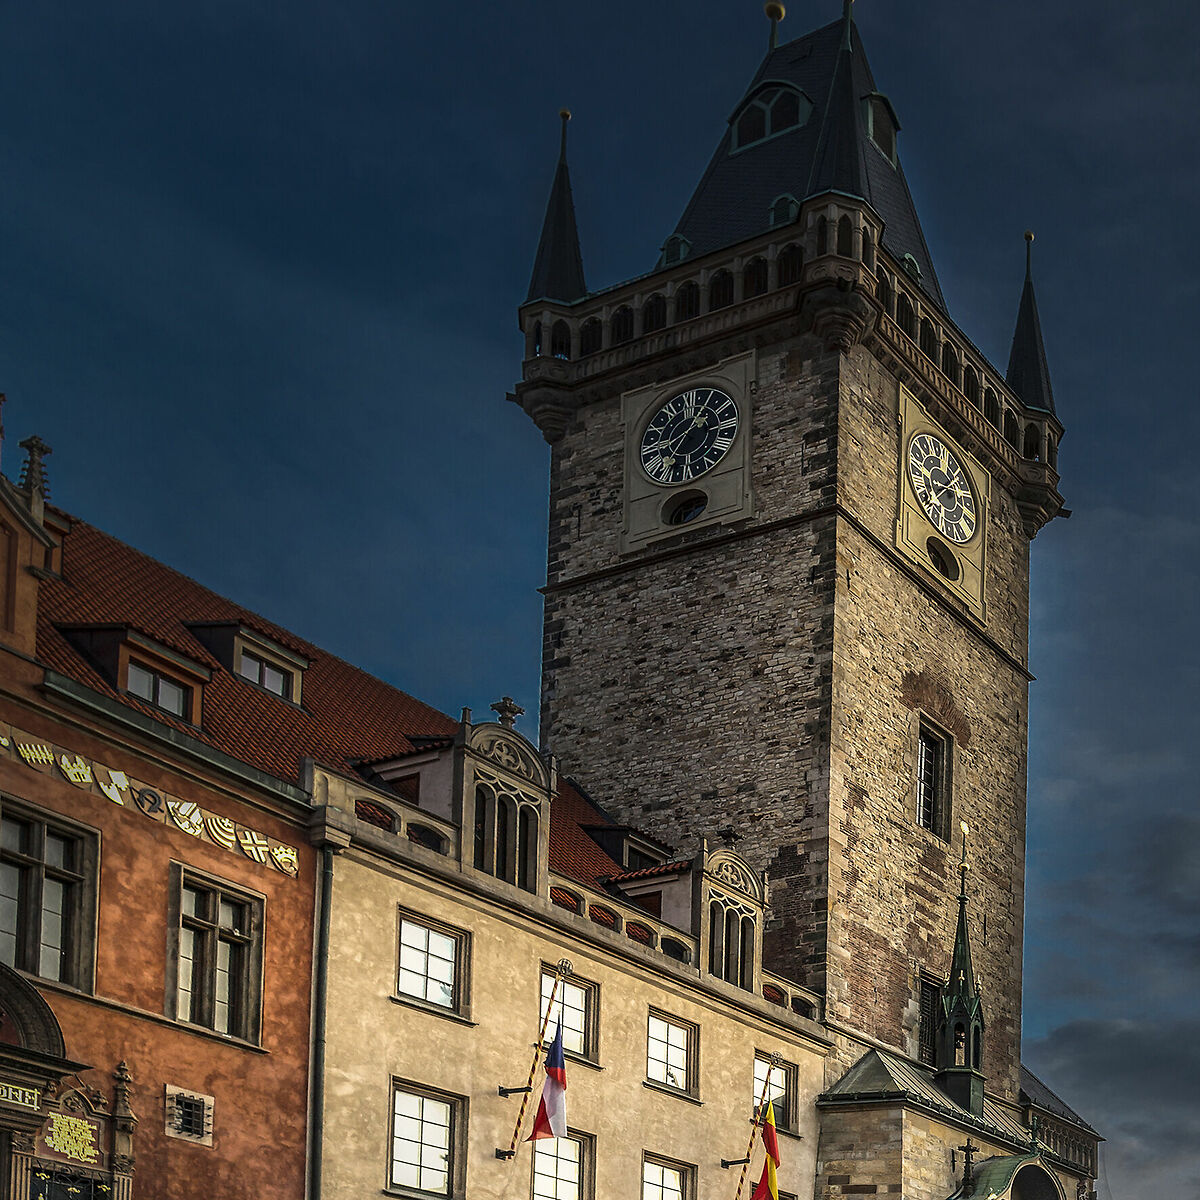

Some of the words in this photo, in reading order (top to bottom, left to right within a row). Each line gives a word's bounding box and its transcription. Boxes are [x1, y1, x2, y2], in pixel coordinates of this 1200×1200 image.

[683, 391, 696, 407] XII
[662, 403, 677, 420] XI
[716, 400, 731, 414] II
[647, 423, 665, 435] X
[720, 417, 736, 430] III
[713, 437, 732, 451] IIII
[704, 457, 715, 469] V
